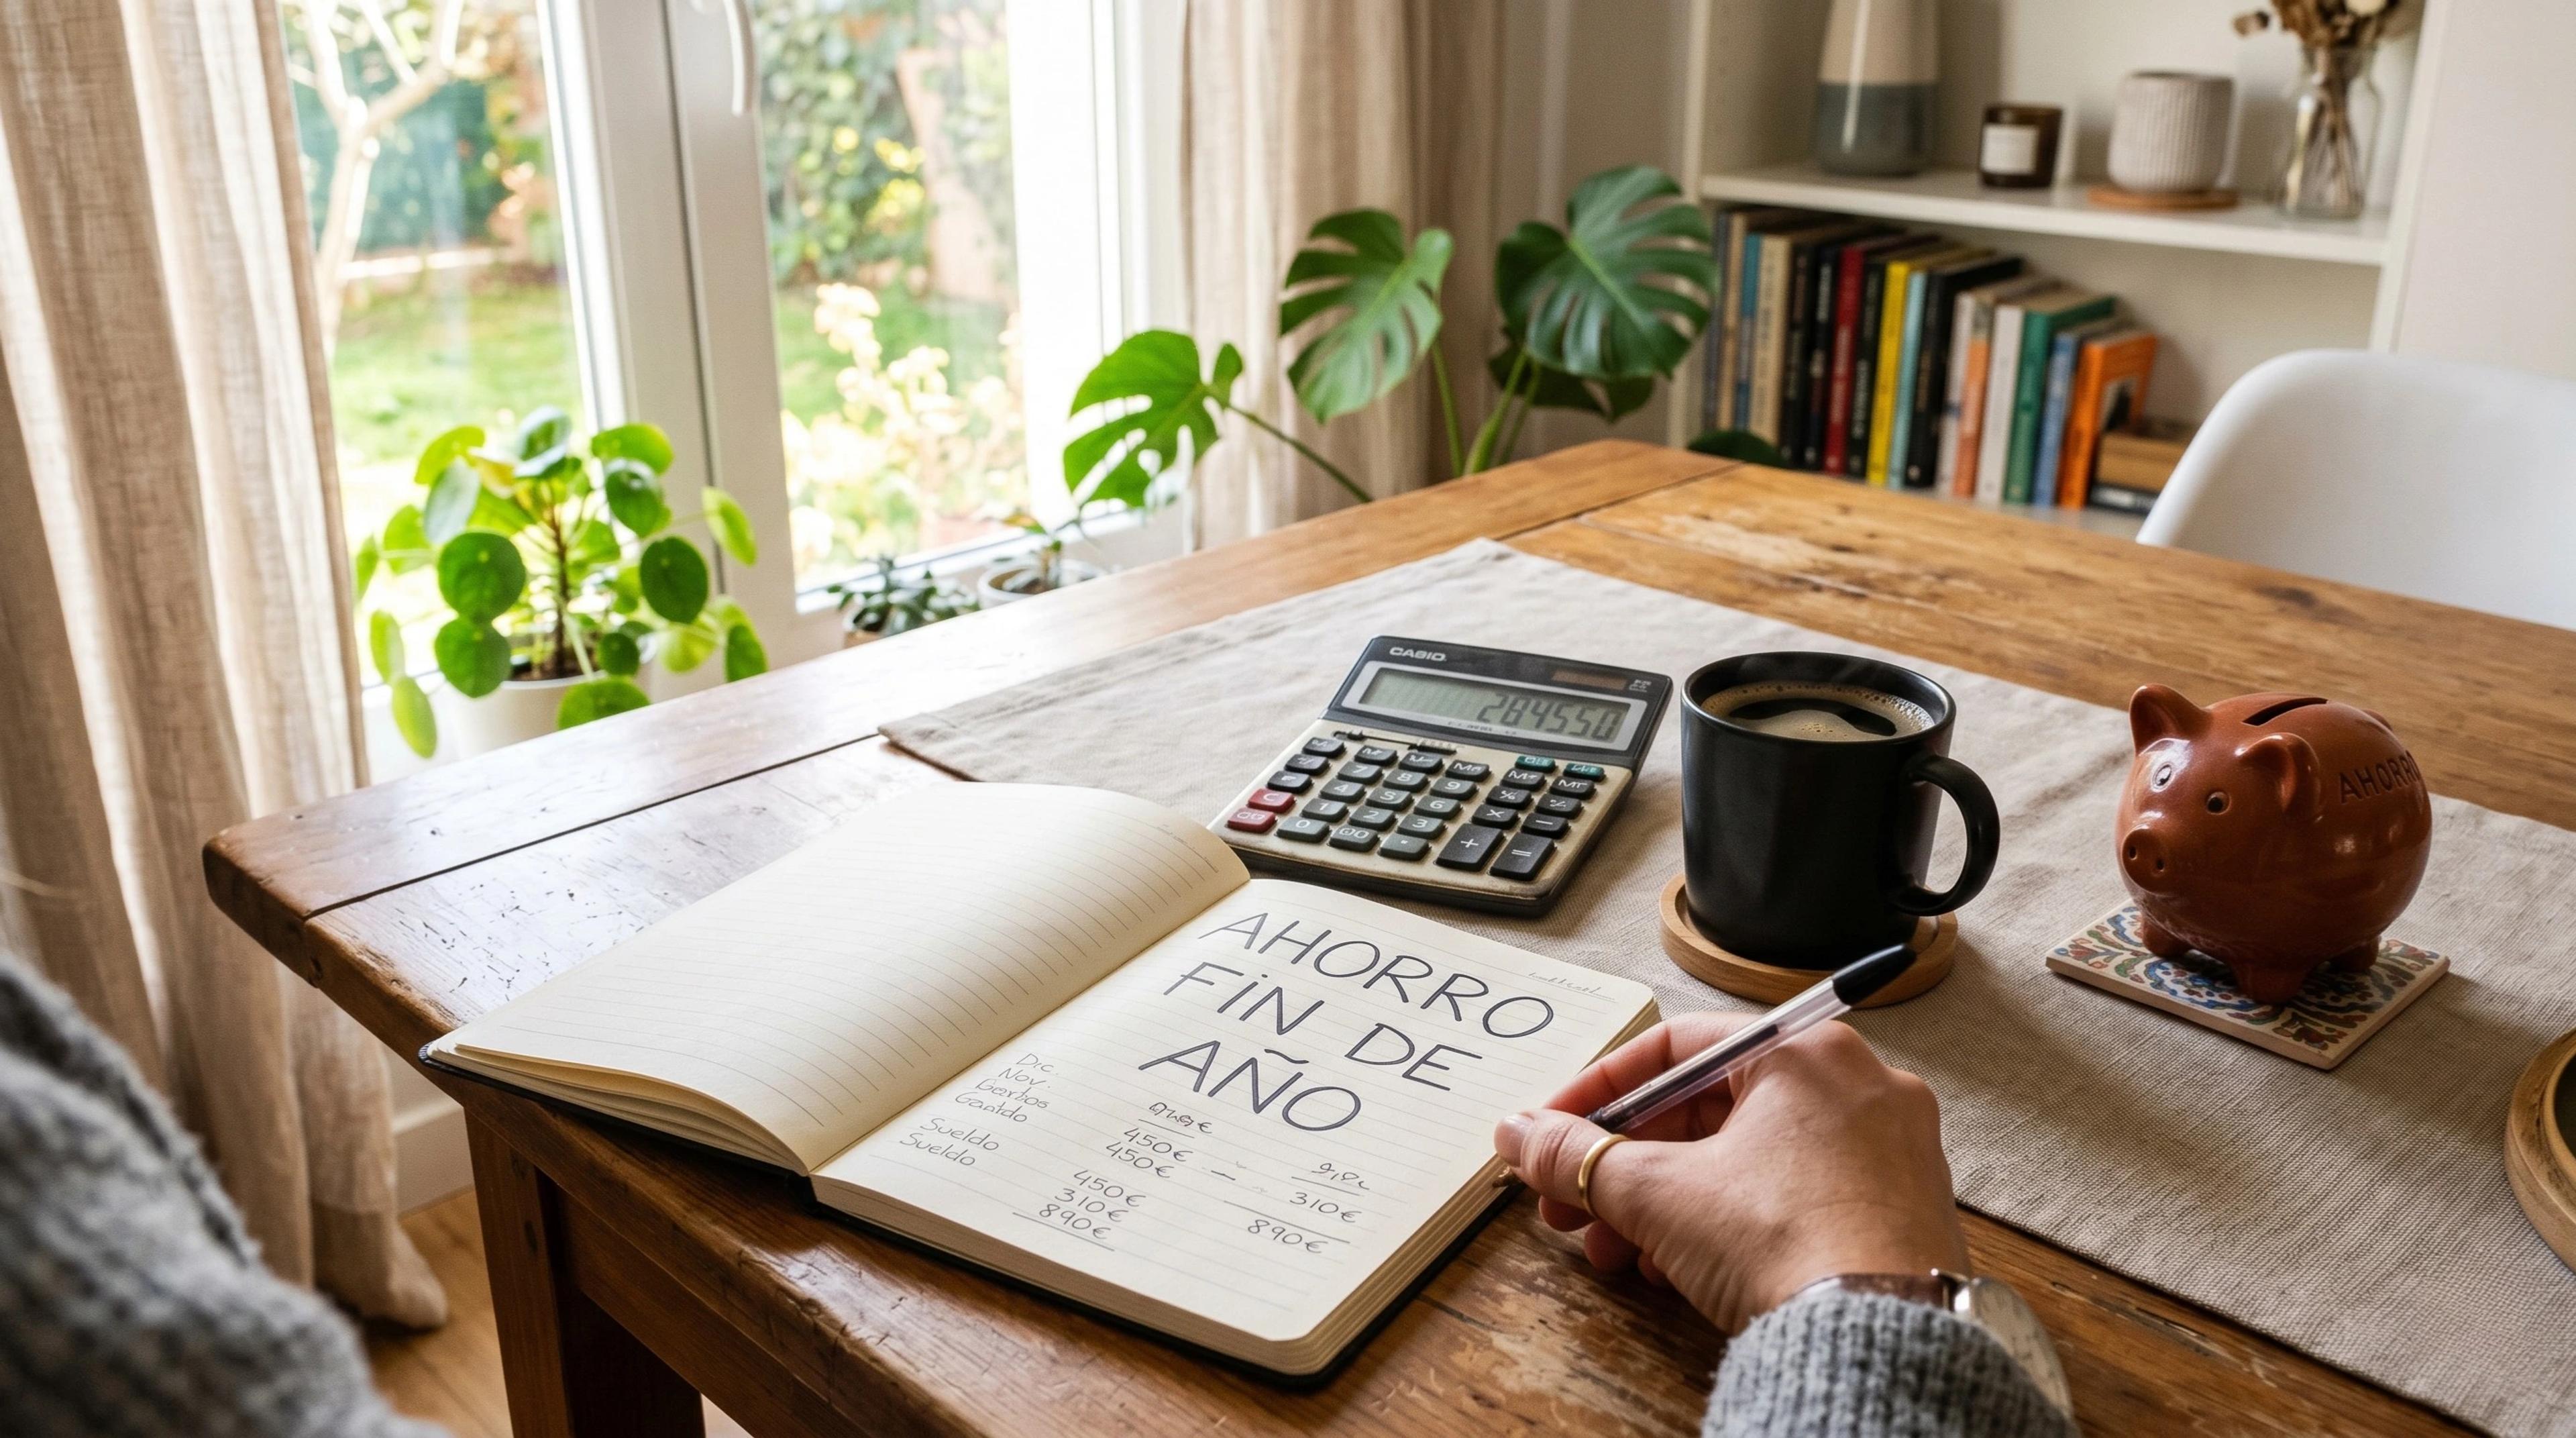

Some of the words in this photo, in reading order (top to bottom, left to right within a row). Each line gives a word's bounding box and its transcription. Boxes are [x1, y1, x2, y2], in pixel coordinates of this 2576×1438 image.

[1389, 646, 1447, 662] CASIO
[1476, 693, 1623, 741] 284550
[1352, 765, 1368, 774] 7
[1397, 773, 1413, 782] 8
[1263, 792, 1279, 802] C
[1334, 784, 1347, 793] 4
[1444, 781, 1461, 790] 9
[1320, 802, 1330, 811] 1
[1363, 811, 1379, 819] 2
[1430, 800, 1446, 809] 6
[1295, 819, 1311, 829] 0
[1412, 819, 1428, 828] 3
[1199, 912, 1554, 1038] AHORRO
[1344, 1022, 1483, 1092] DE
[998, 1068, 1051, 1088] Nov.
[1138, 1039, 1362, 1132] AÑO
[900, 1132, 975, 1166] Sueldo
[920, 1117, 999, 1151] Sueldo
[1124, 1127, 1193, 1162] 450€
[1106, 1141, 1174, 1178] 450€
[1073, 1170, 1146, 1207] 450€
[1054, 1188, 1129, 1222] 310€
[1289, 1192, 1362, 1223] 310€
[1040, 1203, 1111, 1239] 890€
[1248, 1219, 1328, 1253] 890€
